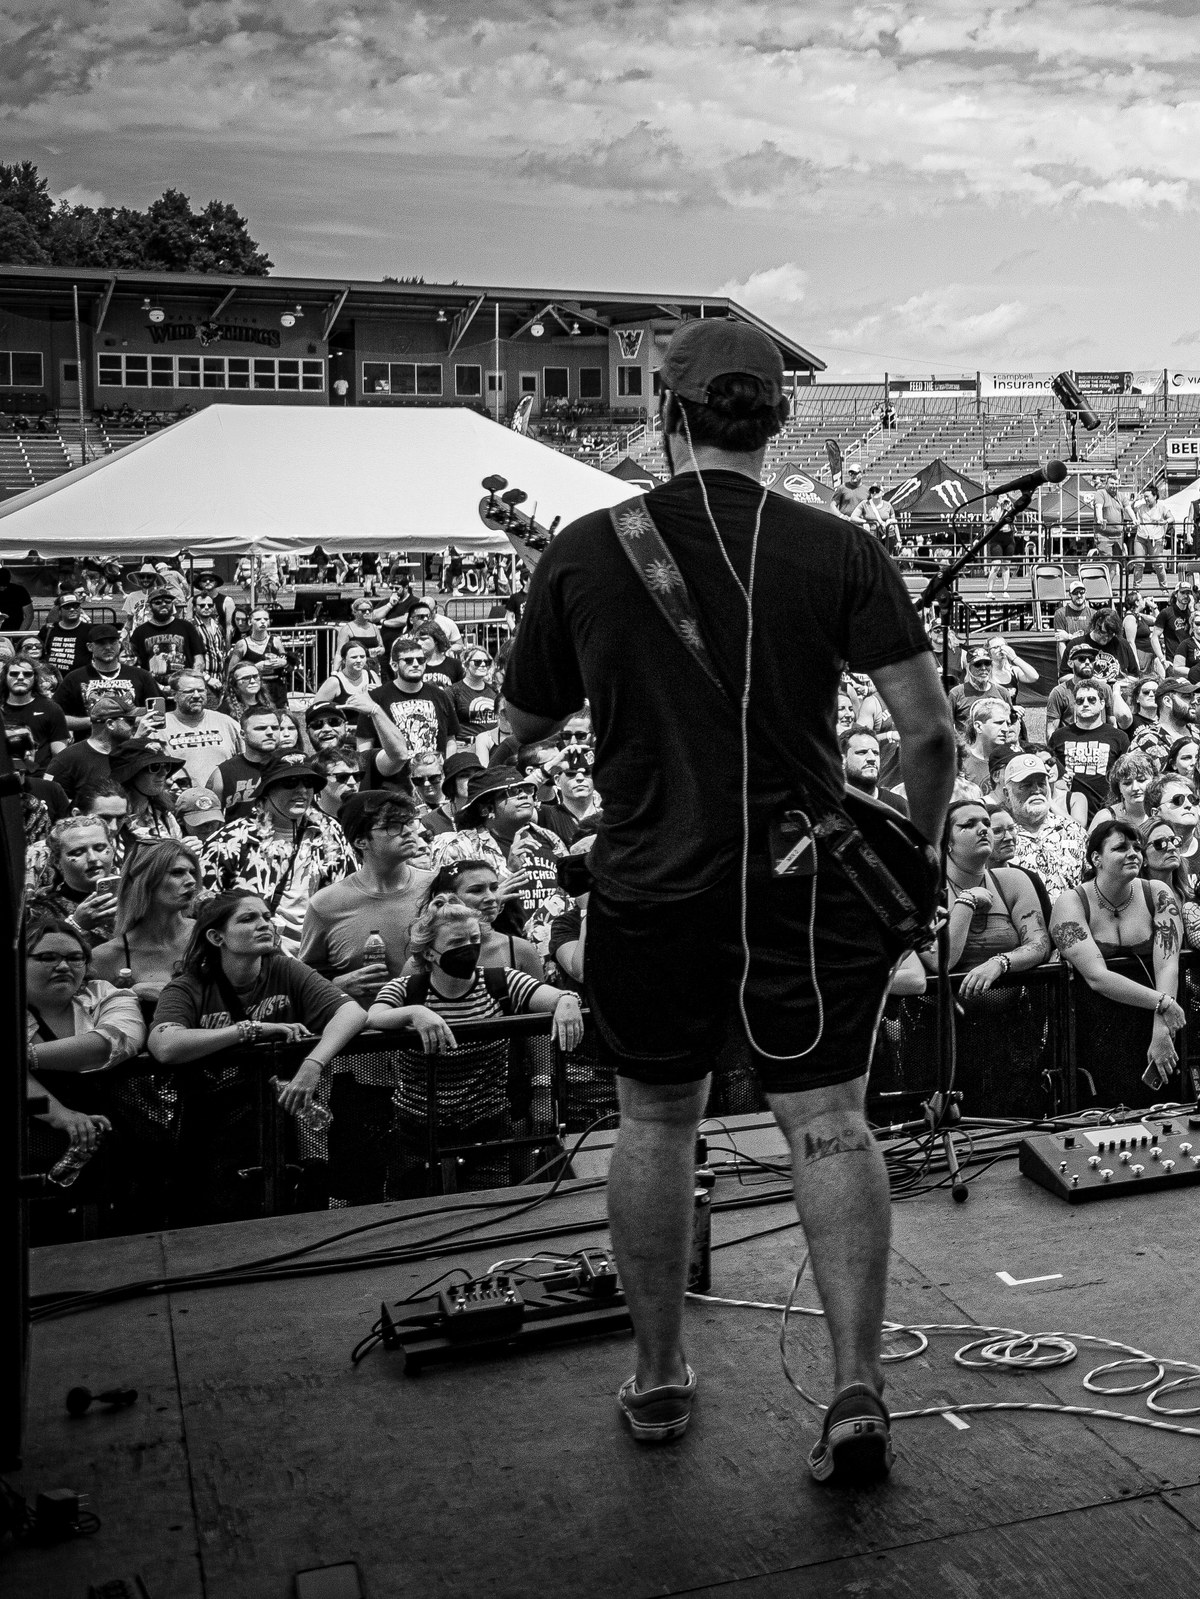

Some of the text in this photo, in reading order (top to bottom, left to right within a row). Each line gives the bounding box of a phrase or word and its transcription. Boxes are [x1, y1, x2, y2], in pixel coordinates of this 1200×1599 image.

[144, 323, 280, 348] WILD THINGS
[997, 373, 1033, 381] campbell
[909, 381, 923, 391] FEED
[924, 381, 934, 391] THE
[1067, 747, 1100, 757] FOUR
[534, 857, 558, 873] ELLIS
[526, 870, 556, 880] TCHED
[536, 880, 543, 888] A
[532, 888, 557, 899] HITTE
[523, 899, 535, 910] ON
